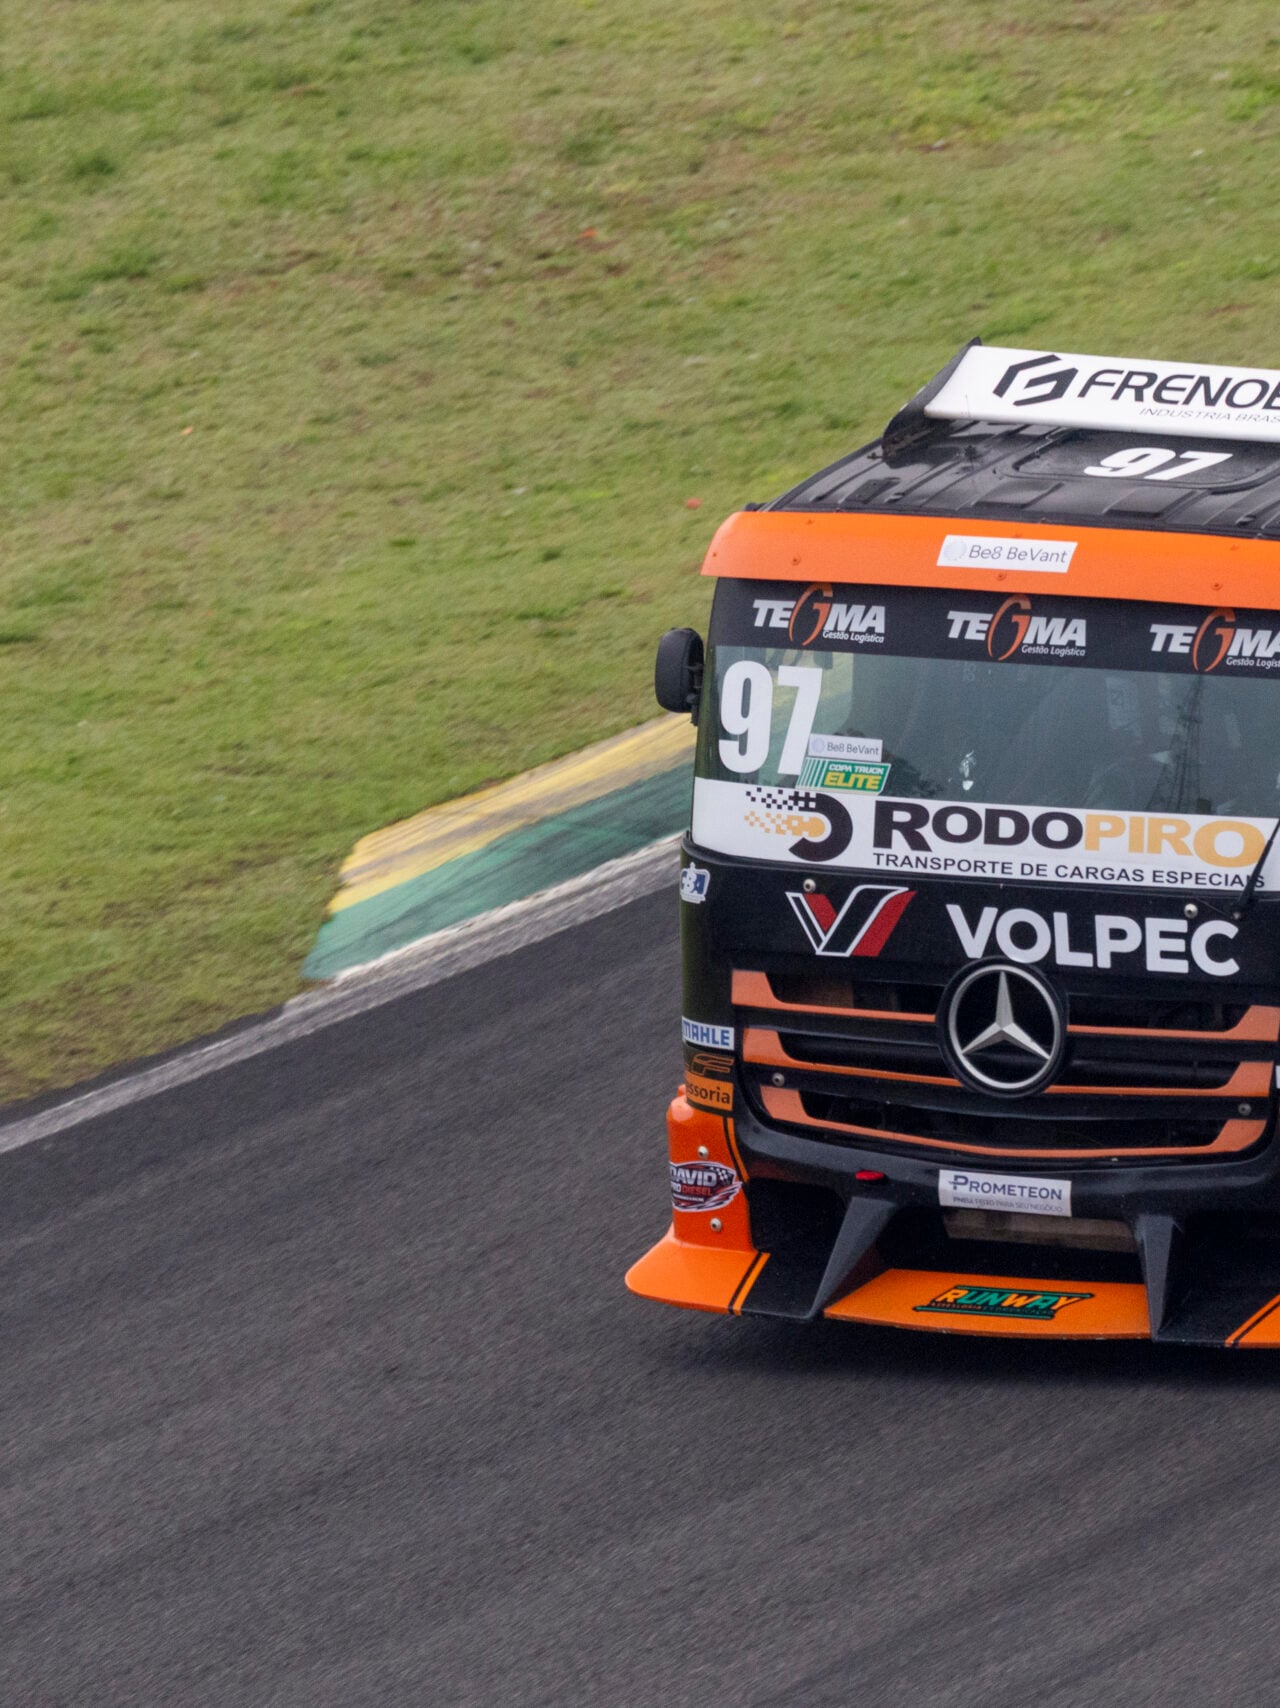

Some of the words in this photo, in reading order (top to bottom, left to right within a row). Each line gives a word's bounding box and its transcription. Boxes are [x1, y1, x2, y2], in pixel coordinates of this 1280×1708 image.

[1084, 447, 1233, 481] 97
[968, 544, 1003, 560] Be8
[1006, 546, 1068, 563] BeVant
[753, 582, 885, 646] TEGMA
[822, 630, 849, 641] Gestão
[850, 632, 885, 644] Logística
[947, 594, 1087, 661] TEGMA
[1021, 644, 1049, 655] Gestão
[1050, 645, 1086, 658] Logística
[1226, 656, 1255, 667] Gestão
[718, 660, 823, 775] 97
[846, 743, 880, 756] BeVant
[824, 771, 882, 790] ELITE
[873, 799, 1266, 869] RODOPIRO
[872, 852, 1014, 876] TRANSPORTE
[1020, 862, 1048, 878] DE
[1054, 864, 1145, 883] CARGAS
[946, 904, 1240, 976] VOLPEC
[683, 1020, 731, 1046] MAHLE
[669, 1165, 717, 1188] DAVID
[949, 1174, 1063, 1200] PROMETEON
[934, 1288, 1082, 1311] RUNWAY
